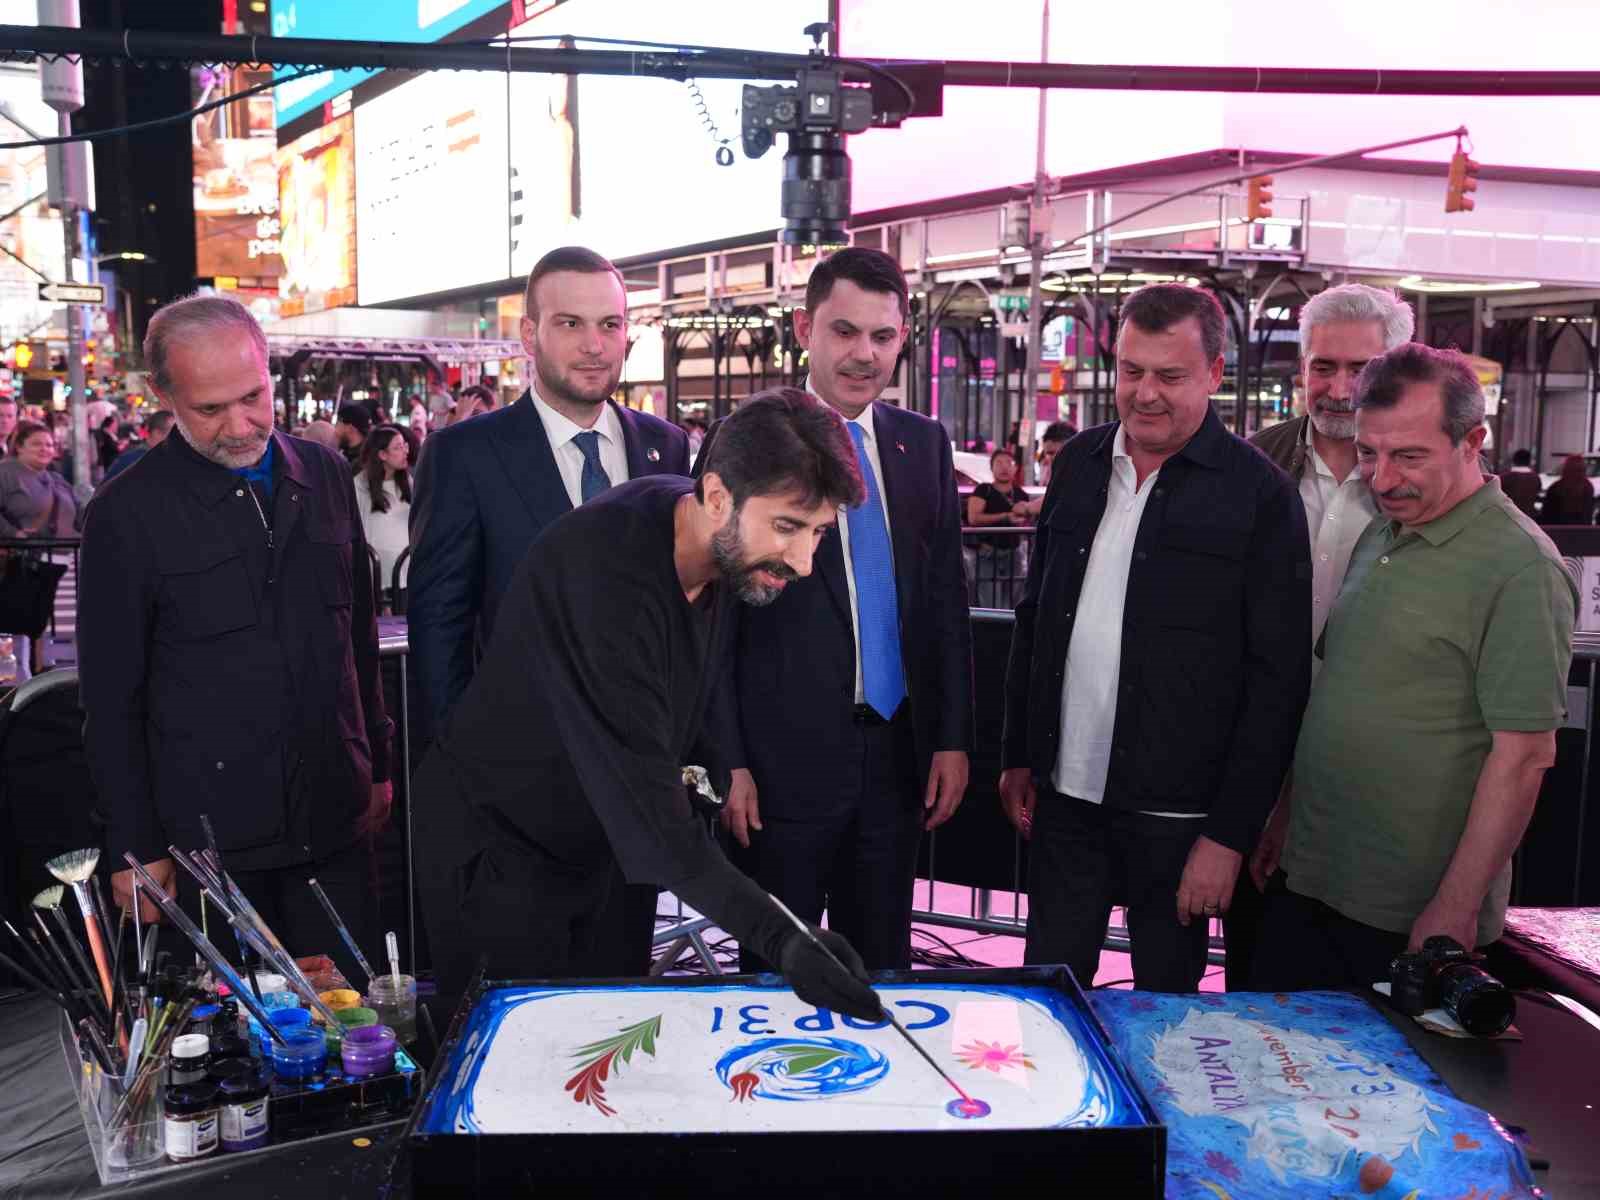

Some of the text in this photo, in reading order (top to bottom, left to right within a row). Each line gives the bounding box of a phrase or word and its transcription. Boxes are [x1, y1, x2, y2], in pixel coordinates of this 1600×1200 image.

[711, 1005, 769, 1034] 31
[1189, 1035, 1248, 1111] ANTALYA
[1259, 1029, 1313, 1092] vember
